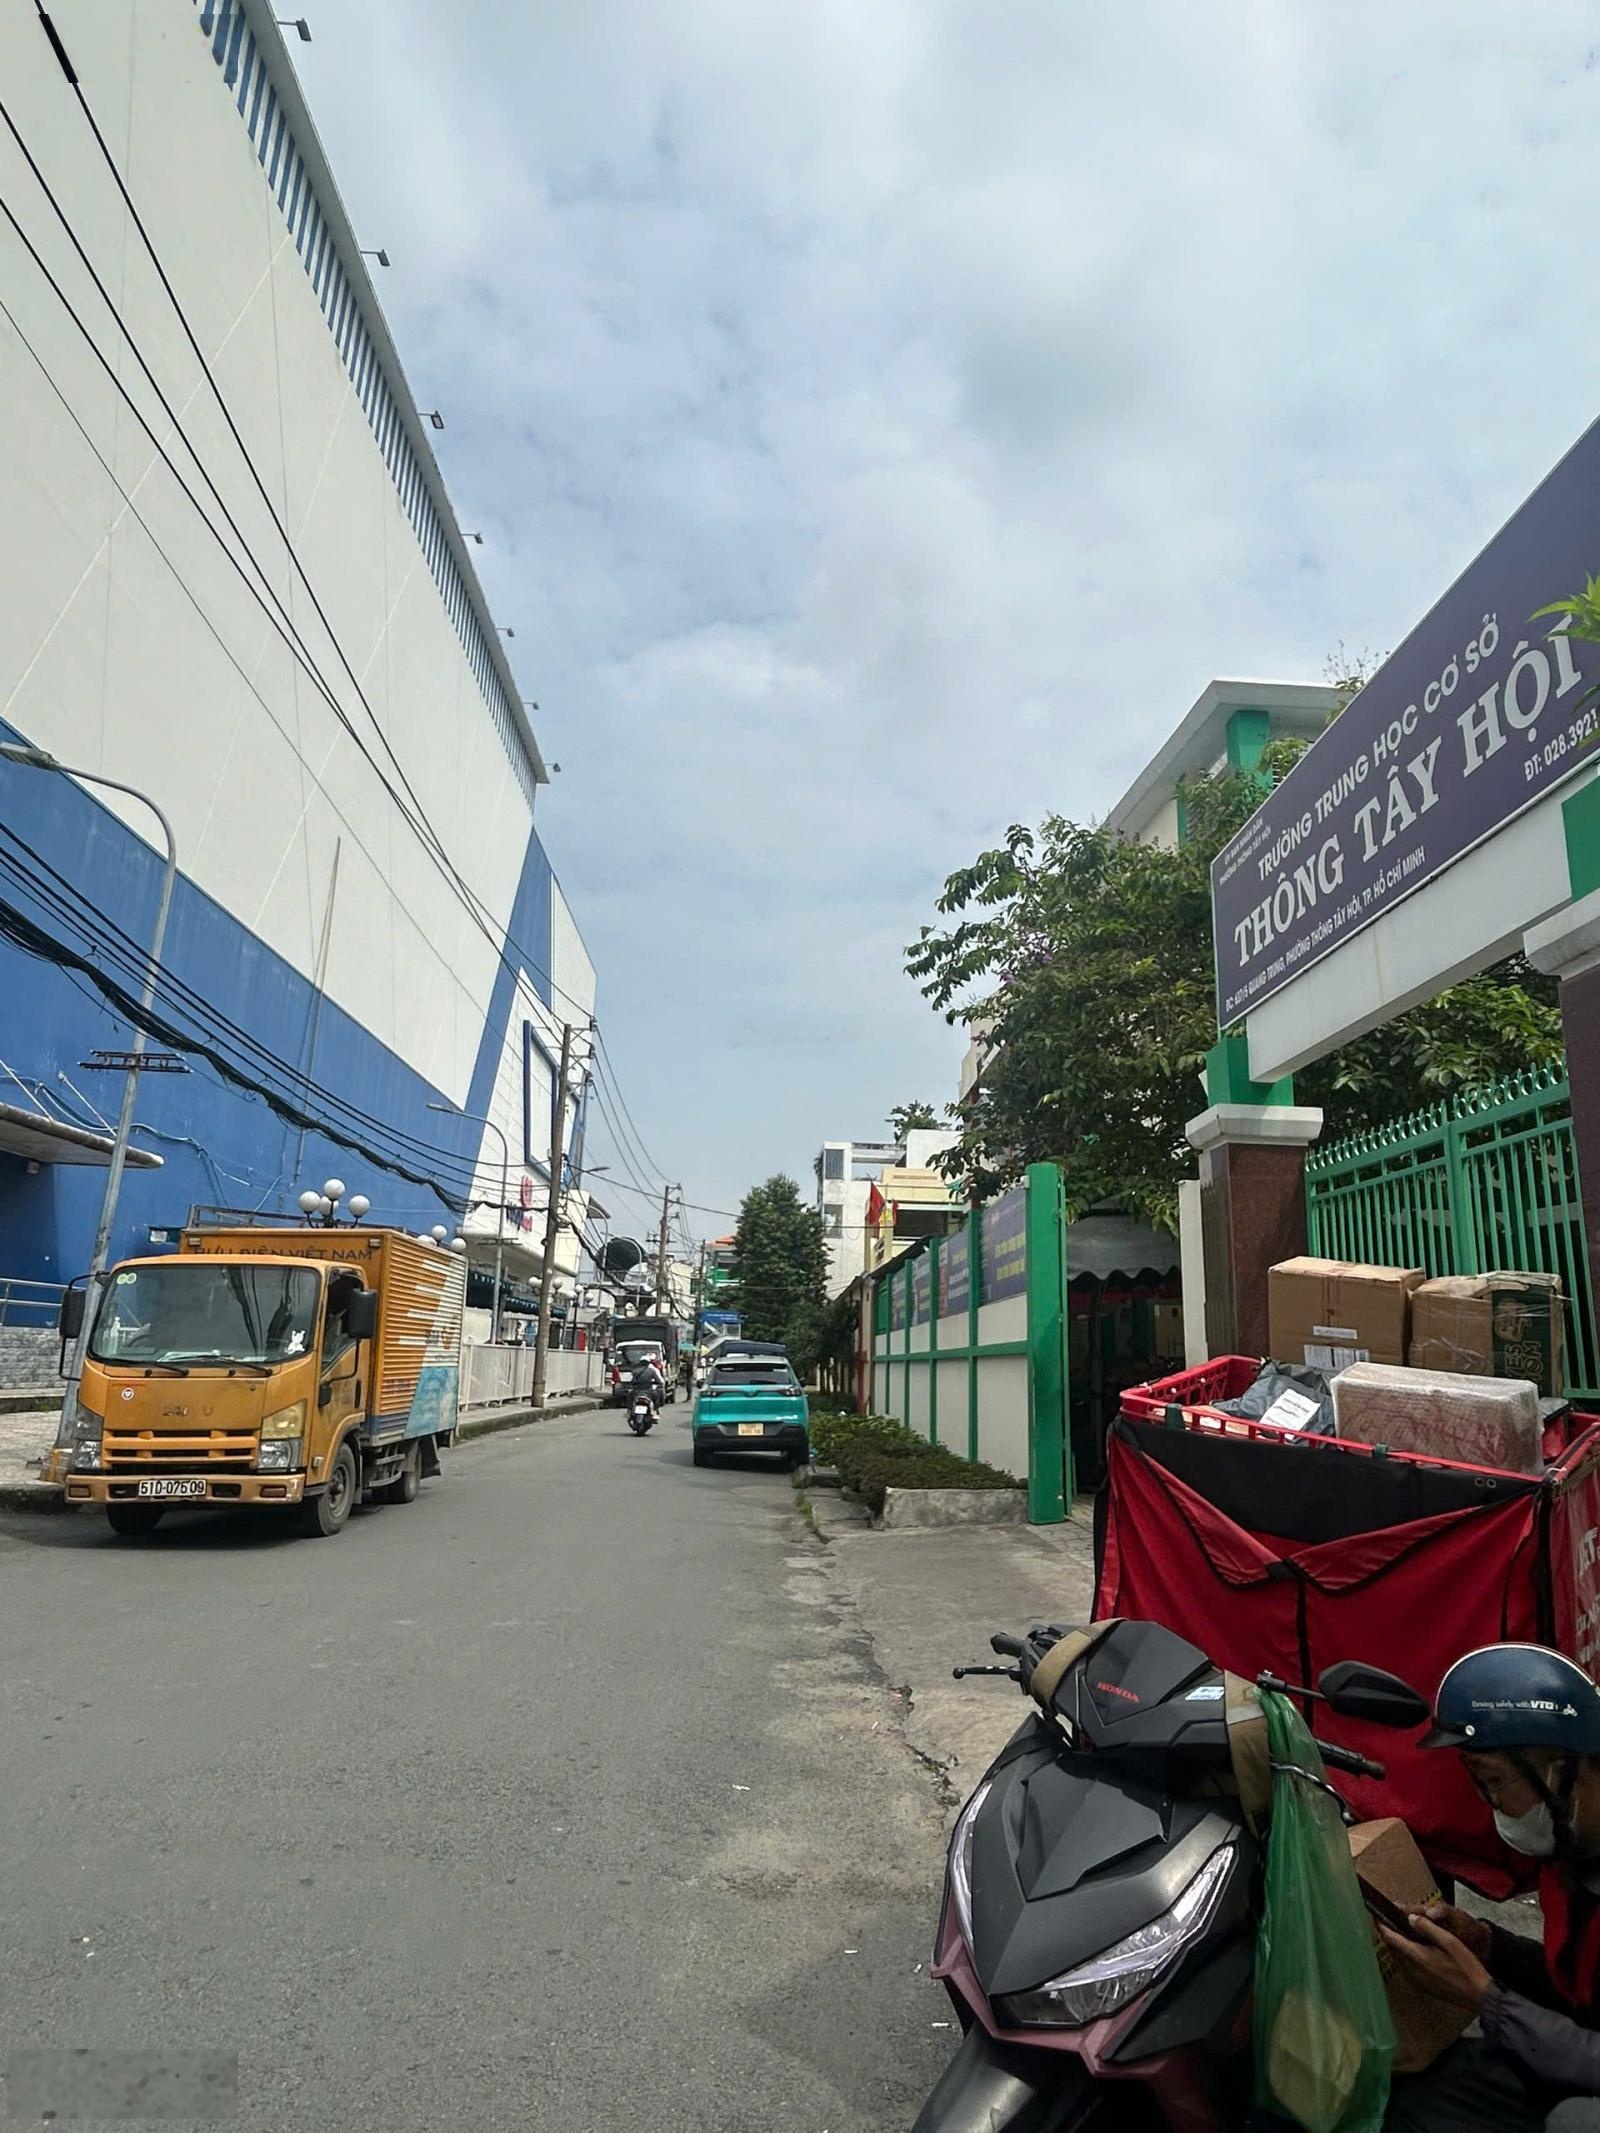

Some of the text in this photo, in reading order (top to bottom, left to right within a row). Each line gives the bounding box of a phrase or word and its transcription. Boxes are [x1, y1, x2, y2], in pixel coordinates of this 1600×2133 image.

[1258, 612, 1499, 881] TRƯỜNG TRUNG HỌC CƠ SỞ
[1524, 750, 1543, 781] ĐT:
[1233, 614, 1583, 967] THÔNG TÂY HỘI
[1310, 921, 1333, 947] THÔNG
[1333, 907, 1346, 929] TÂY
[1362, 887, 1373, 907] TP.
[1373, 869, 1386, 898] HỒ
[1386, 857, 1402, 888] CHÍ
[1402, 845, 1426, 876] MINH
[332, 1248, 373, 1260] NAM
[1096, 1682, 1139, 1703] HONDA
